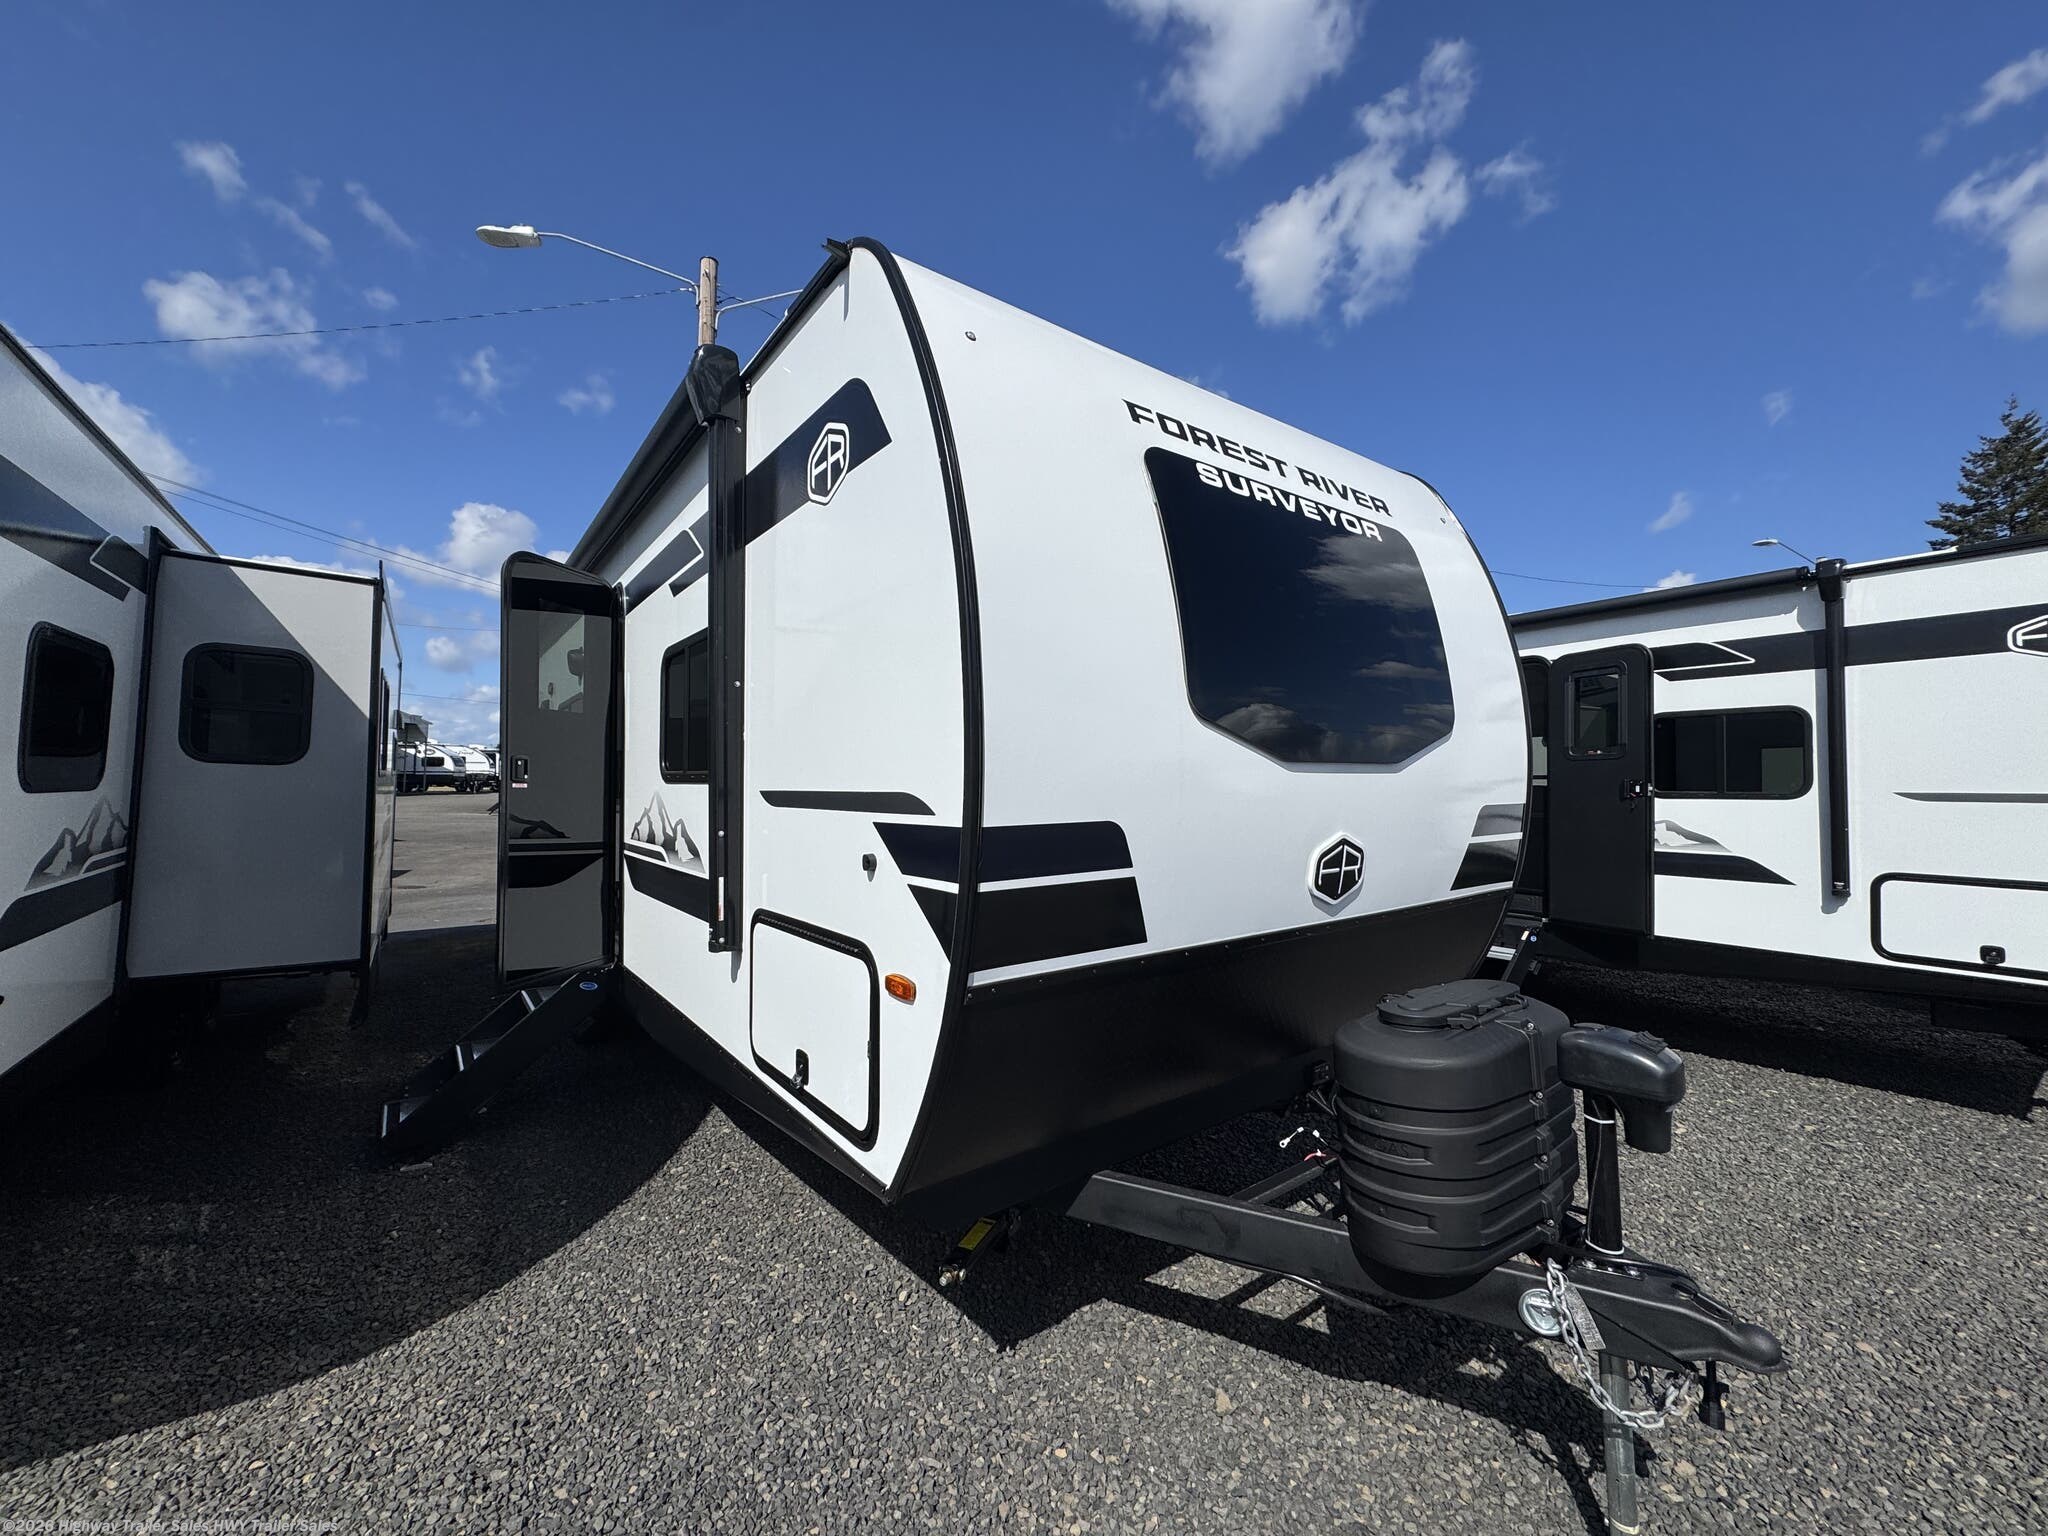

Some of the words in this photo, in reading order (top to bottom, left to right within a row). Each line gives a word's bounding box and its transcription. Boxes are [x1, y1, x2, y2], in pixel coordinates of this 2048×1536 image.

[1122, 399, 1288, 478] FOREST
[1295, 466, 1393, 517] RIVER
[1196, 462, 1383, 542] SURVEYOR
